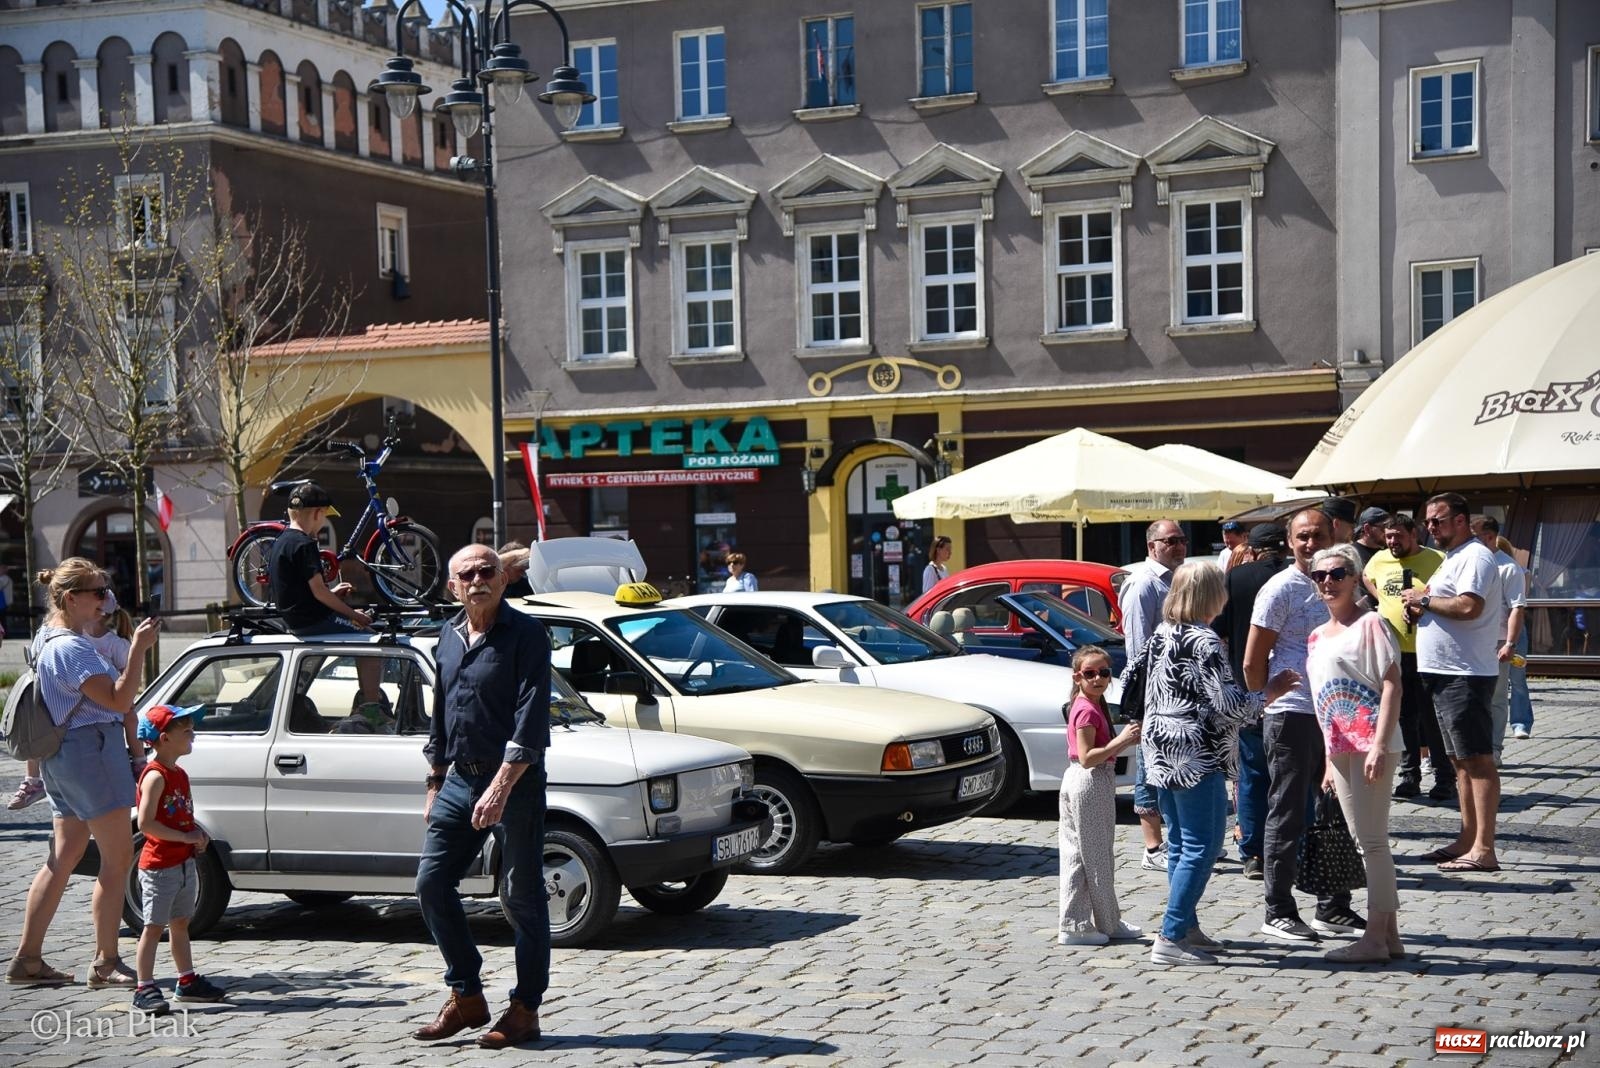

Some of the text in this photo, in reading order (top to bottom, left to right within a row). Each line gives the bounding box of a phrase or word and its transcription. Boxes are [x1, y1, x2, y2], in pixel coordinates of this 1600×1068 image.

[532, 415, 779, 459] APTEKA
[688, 456, 717, 466] POD
[550, 477, 584, 486] RYNEK
[586, 475, 599, 484] 12
[606, 474, 657, 484] CENTRUM
[659, 471, 754, 482] FARMACEUTYCZNE
[629, 584, 660, 599] TAXI
[718, 836, 736, 859] SBL
